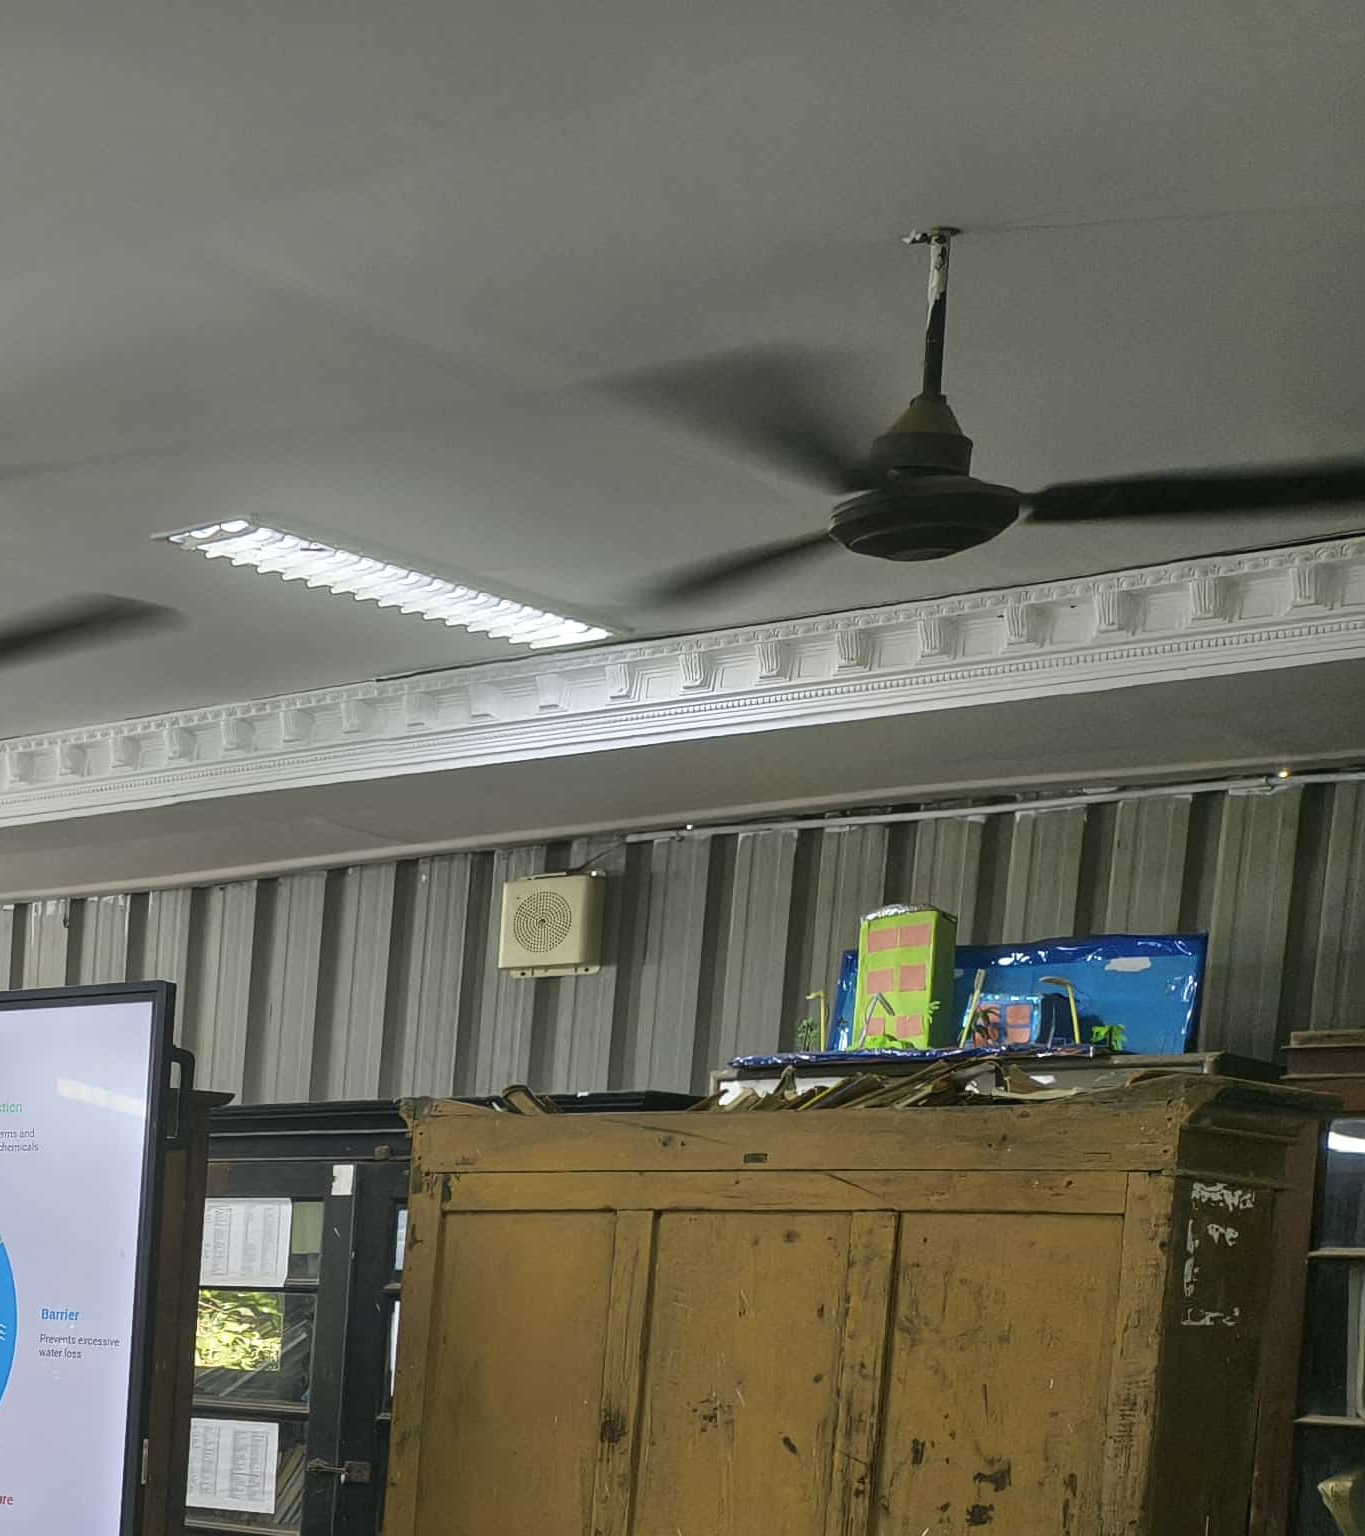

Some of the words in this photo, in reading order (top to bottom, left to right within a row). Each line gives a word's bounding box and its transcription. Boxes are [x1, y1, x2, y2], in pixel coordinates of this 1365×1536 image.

[19, 1127, 35, 1138] and
[41, 1307, 80, 1321] Barrier
[39, 1333, 76, 1345] Prevents
[77, 1335, 121, 1347] excessive
[38, 1348, 63, 1358] water
[64, 1348, 82, 1359] loss
